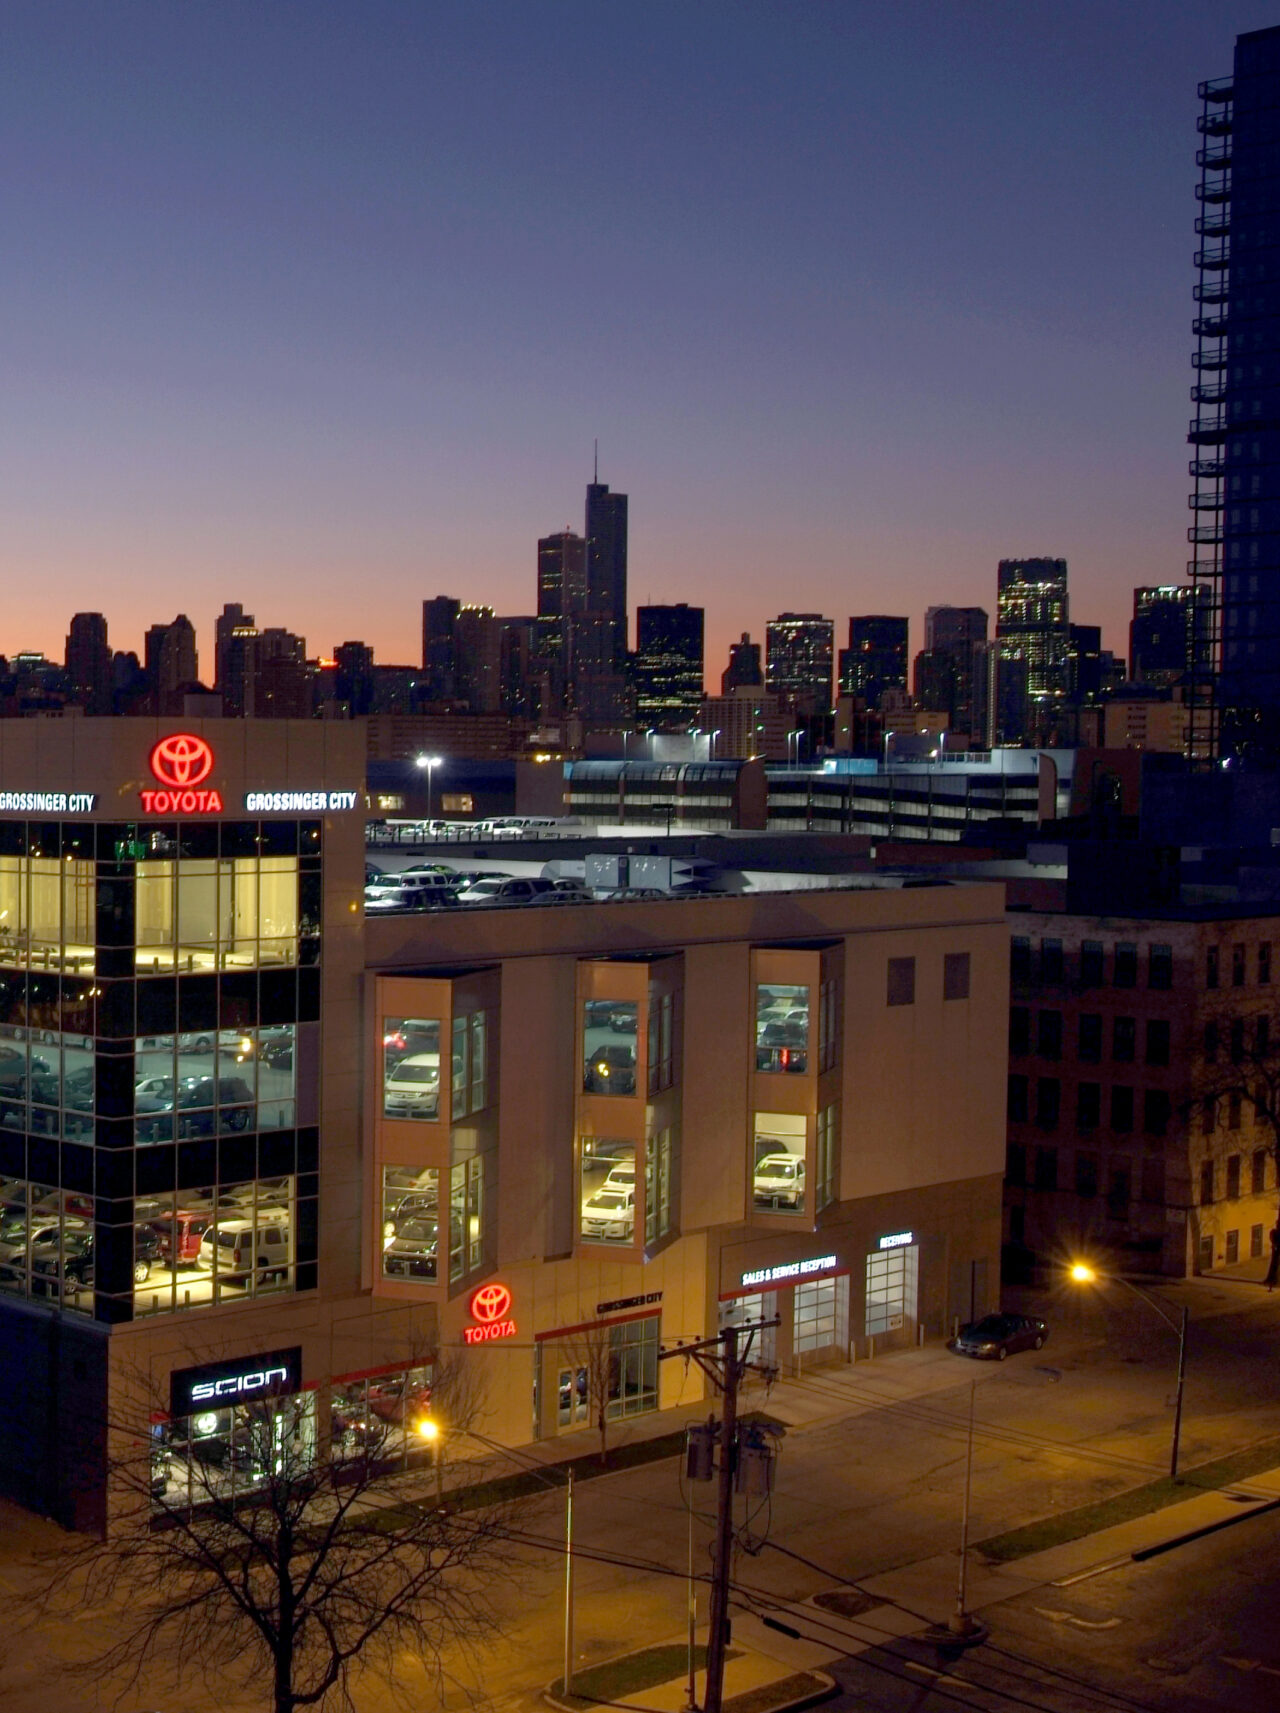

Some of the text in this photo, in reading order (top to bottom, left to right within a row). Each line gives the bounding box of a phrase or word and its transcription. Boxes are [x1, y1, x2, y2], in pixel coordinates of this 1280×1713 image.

[68, 794, 94, 812] CITY
[141, 790, 222, 813] TOYOTA
[246, 792, 357, 811] GROSSINGER CITY
[879, 1231, 913, 1249] RECEIVING
[742, 1256, 836, 1285] SALES & SERVICE RECEPTION
[646, 1291, 663, 1304] CITY
[465, 1319, 517, 1344] TOYOTA
